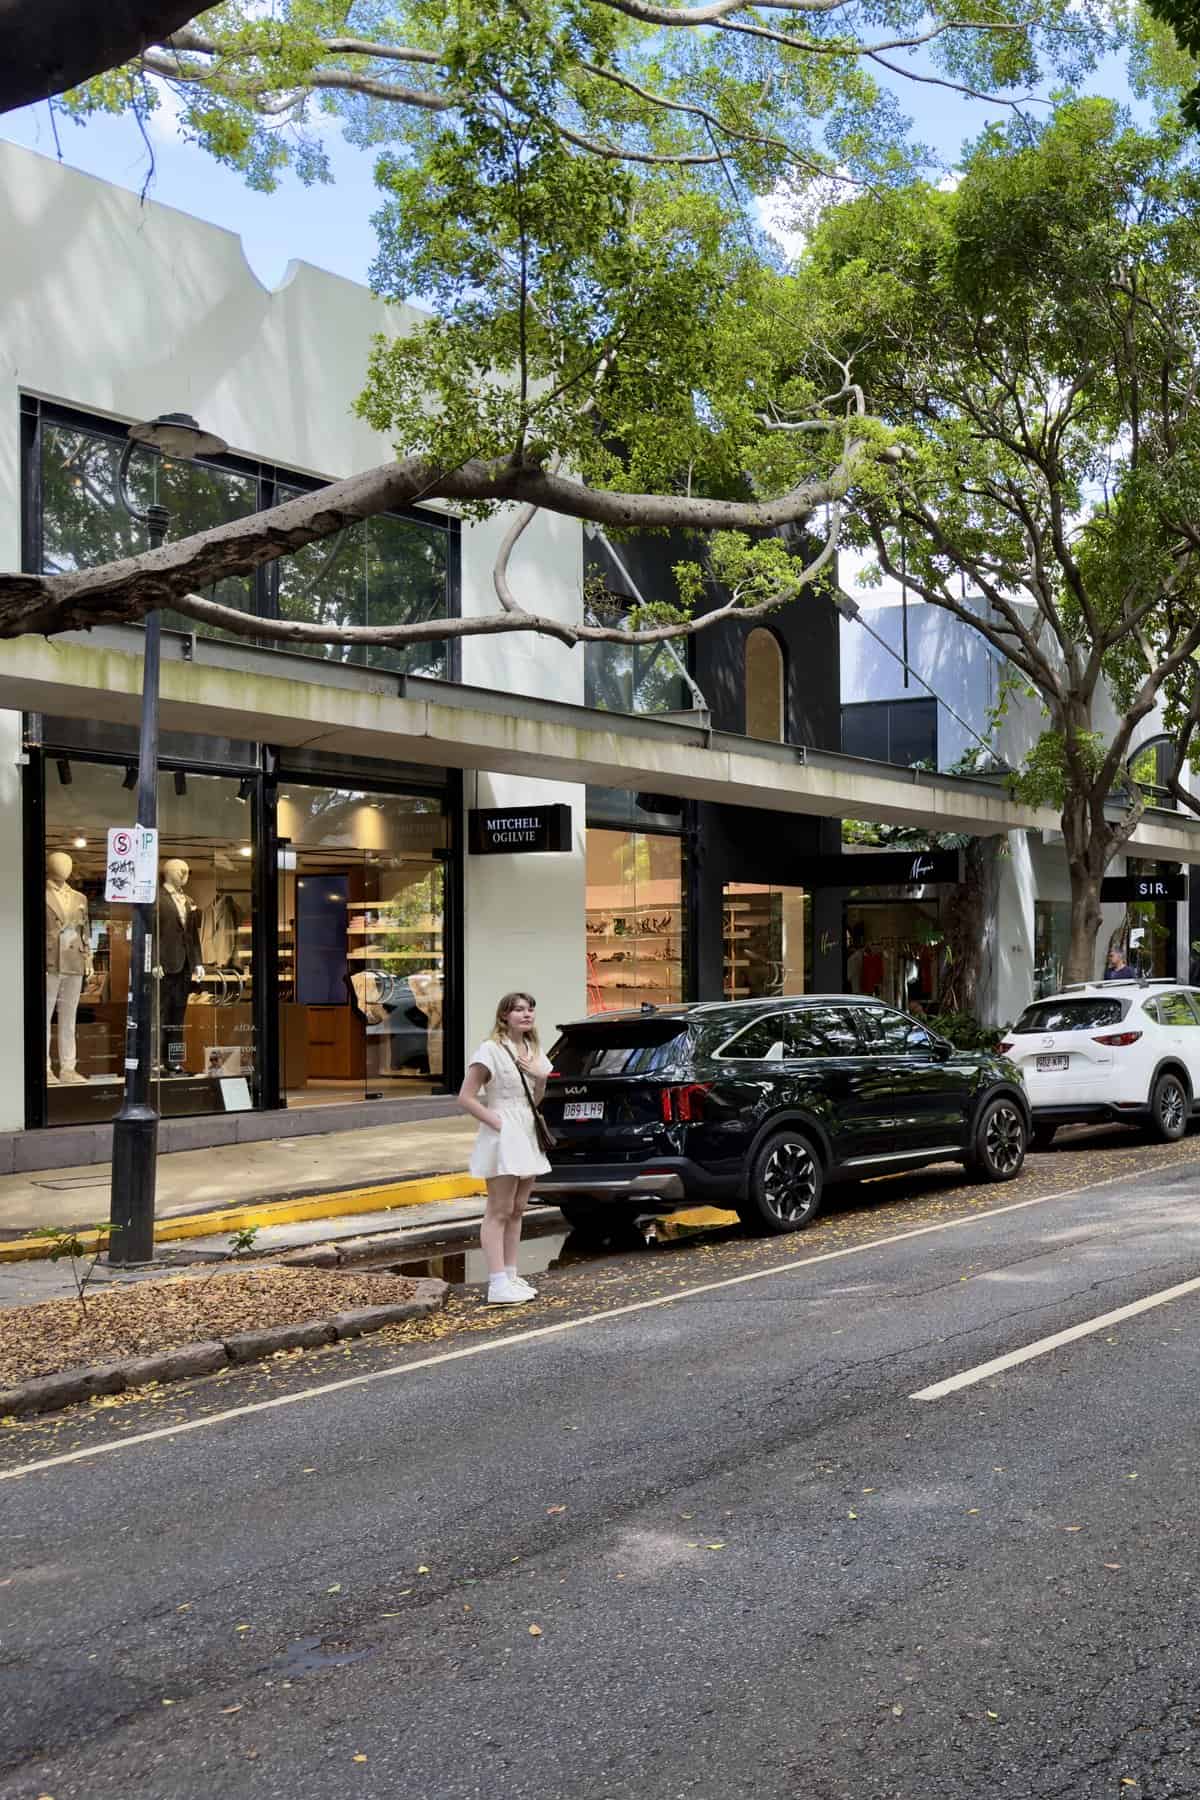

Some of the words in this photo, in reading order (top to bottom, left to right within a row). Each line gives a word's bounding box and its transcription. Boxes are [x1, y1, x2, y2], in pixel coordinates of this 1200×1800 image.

[487, 817, 542, 830] MITCHELL
[492, 831, 536, 843] OGILVIE
[1139, 882, 1168, 895] SIR.
[564, 1085, 588, 1095] KIA
